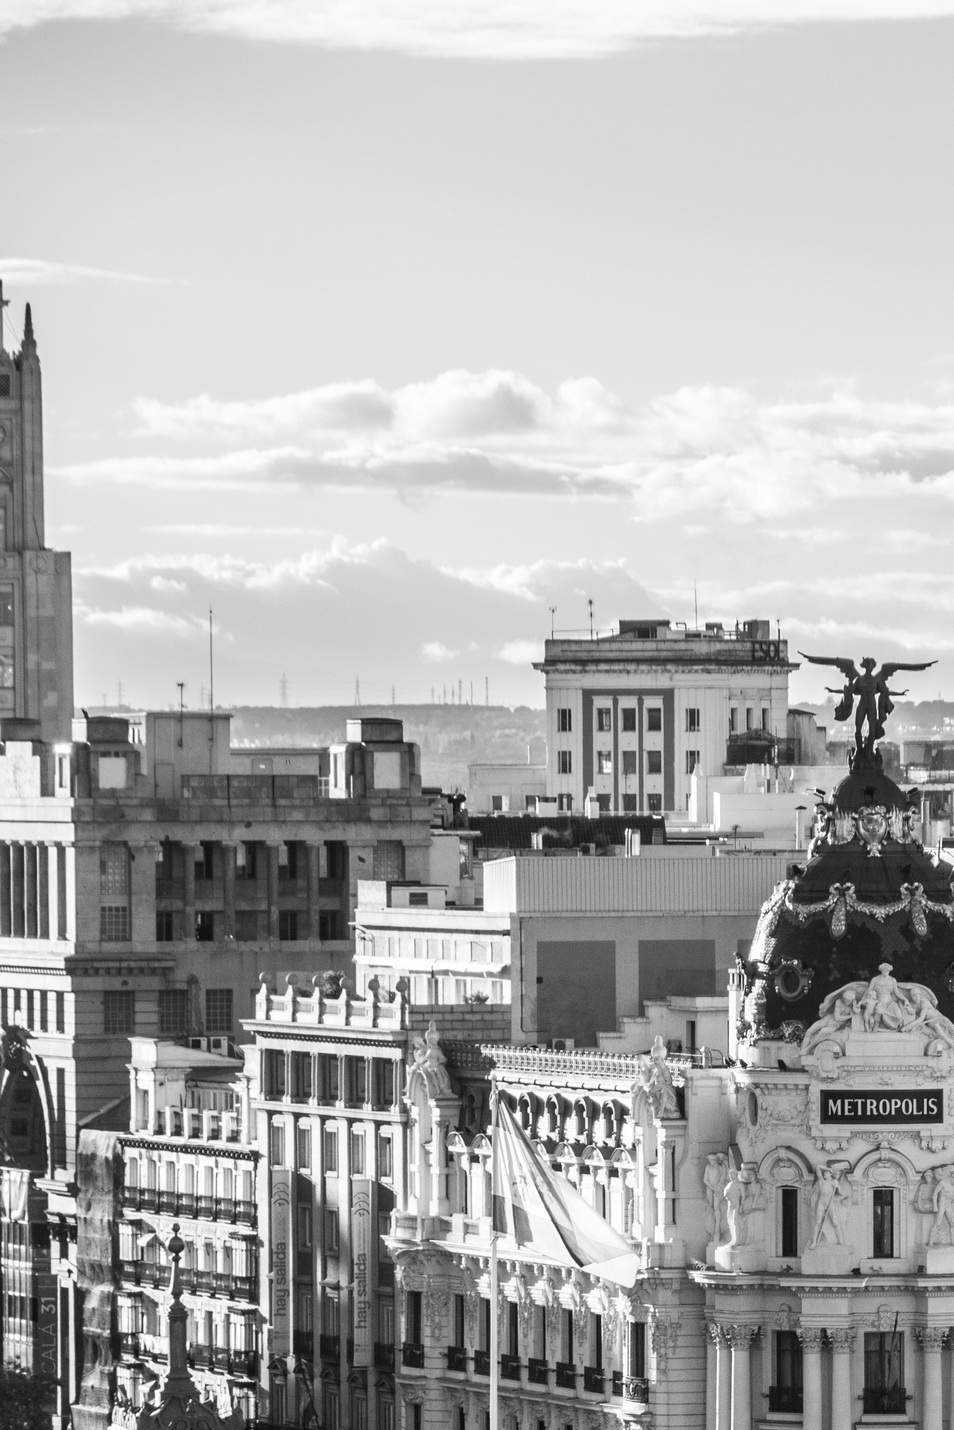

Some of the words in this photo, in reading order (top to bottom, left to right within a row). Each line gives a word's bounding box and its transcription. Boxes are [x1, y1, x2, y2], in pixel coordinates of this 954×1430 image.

[828, 1098, 938, 1116] METROPOLIS
[274, 1242, 286, 1287] salida
[355, 1253, 368, 1296] salida
[41, 1297, 56, 1314] 31
[274, 1290, 290, 1317] hay
[355, 1302, 371, 1329] hay
